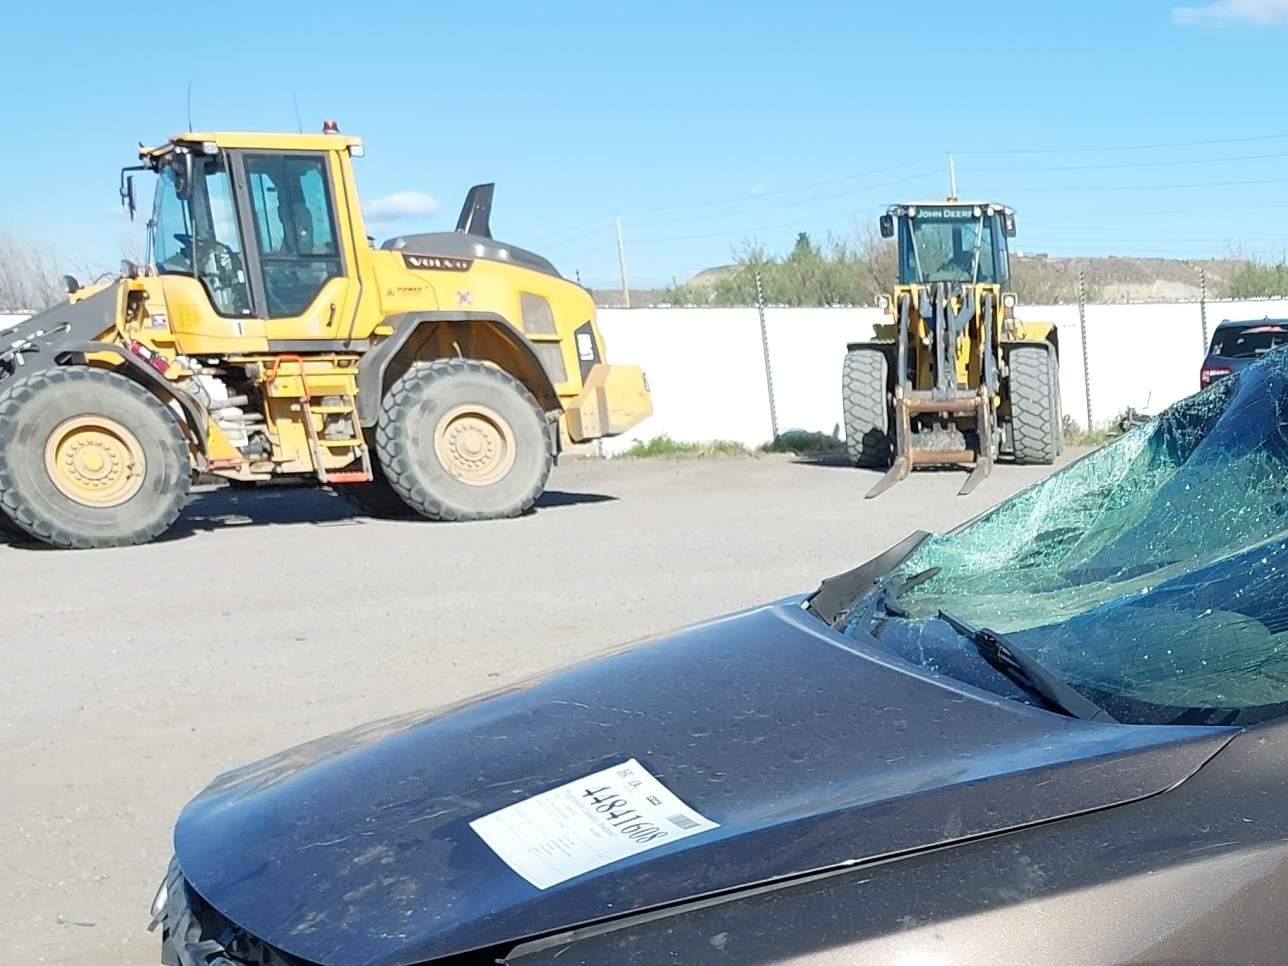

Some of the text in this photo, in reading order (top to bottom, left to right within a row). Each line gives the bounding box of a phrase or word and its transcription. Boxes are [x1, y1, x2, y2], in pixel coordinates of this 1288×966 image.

[917, 209, 942, 218] JOHN
[408, 256, 468, 269] VOLVO
[582, 786, 669, 845] 44841608
